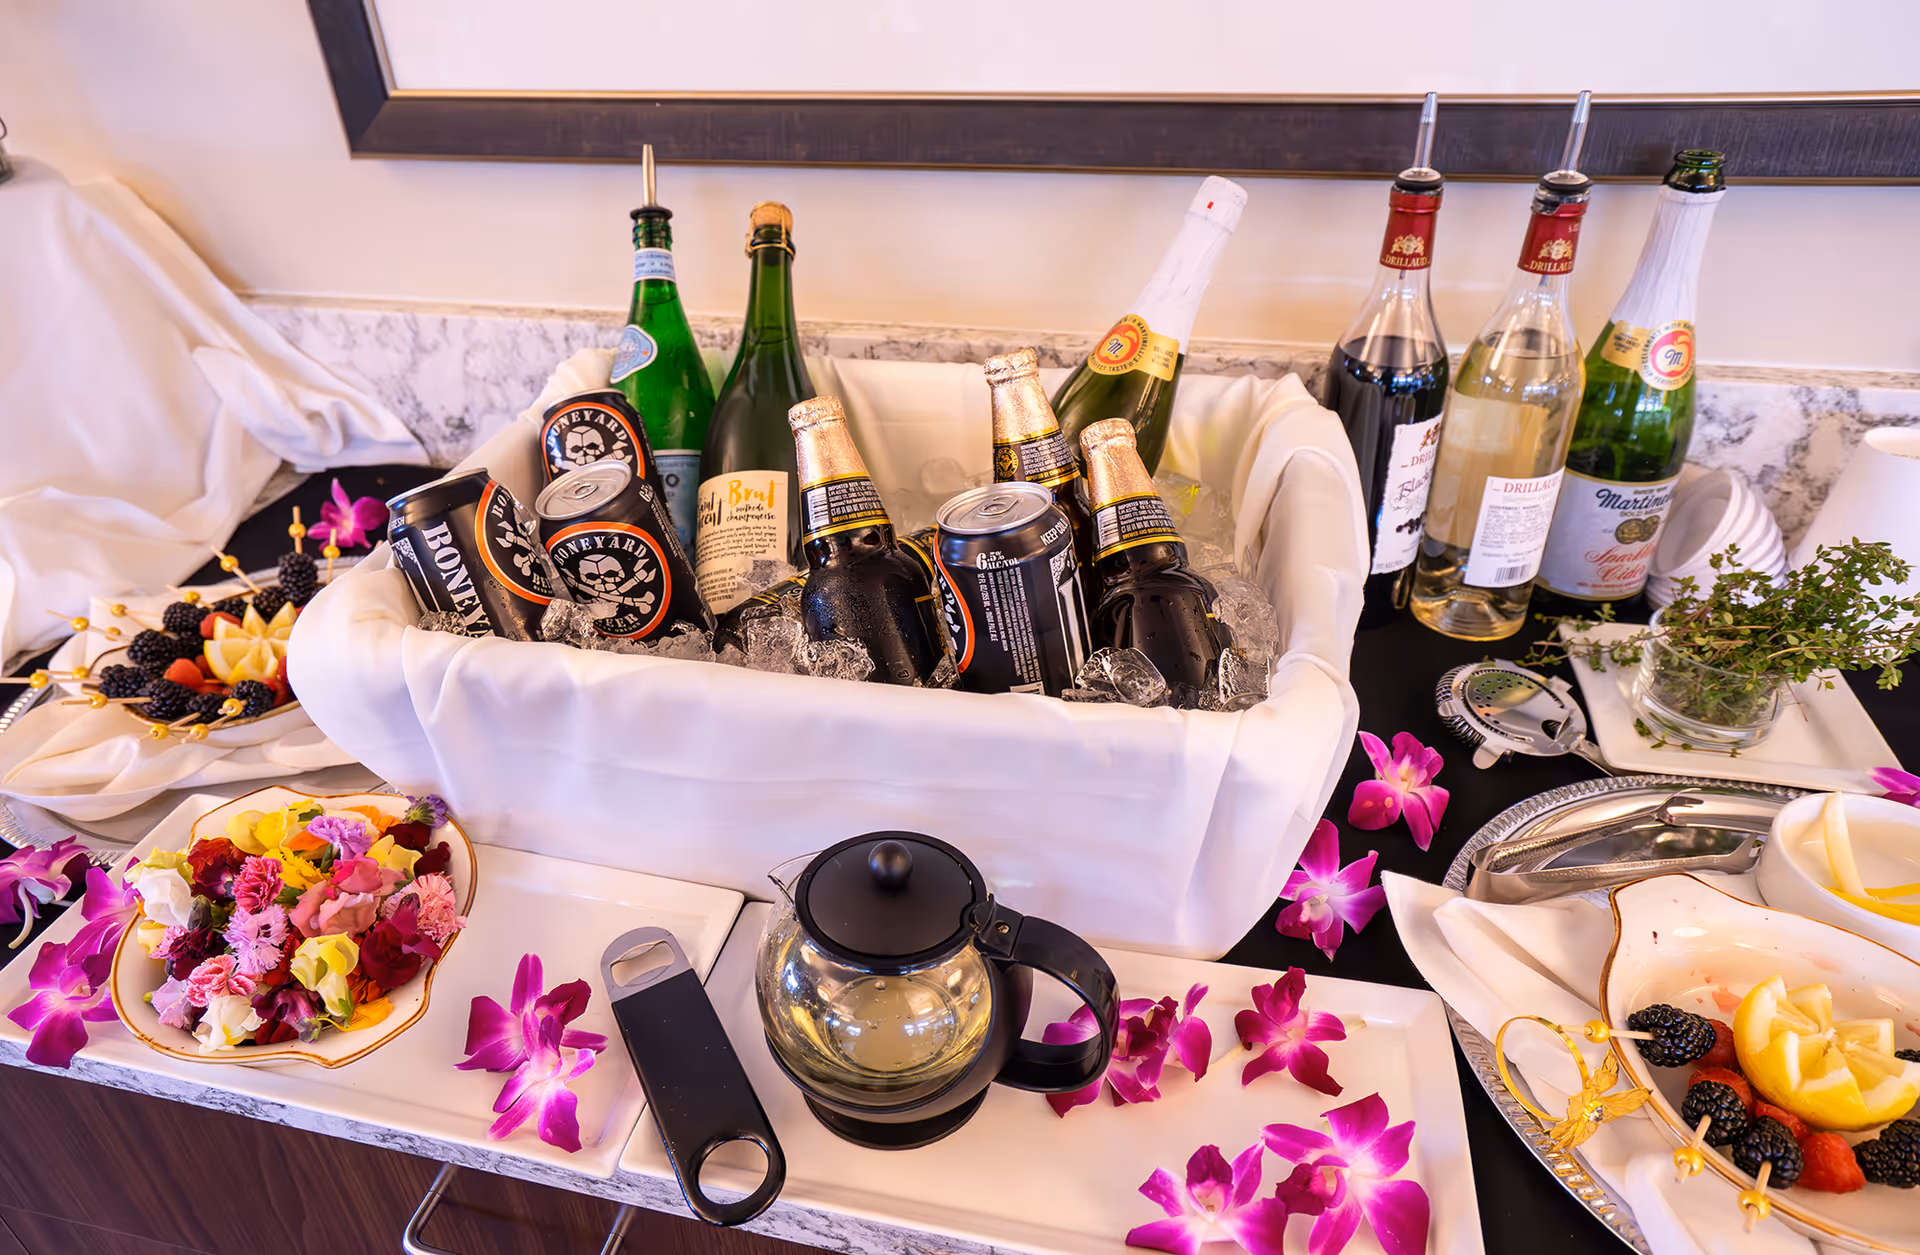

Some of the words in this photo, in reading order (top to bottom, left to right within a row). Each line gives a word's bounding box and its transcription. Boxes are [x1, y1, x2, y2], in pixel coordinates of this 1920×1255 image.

[1384, 254, 1428, 267] DRILLAUD
[547, 410, 628, 448] BONEYARD
[727, 480, 784, 510] Brut
[1040, 527, 1059, 546] KEEP
[554, 535, 648, 566] BONEYARD
[976, 551, 1005, 570] 6.5%
